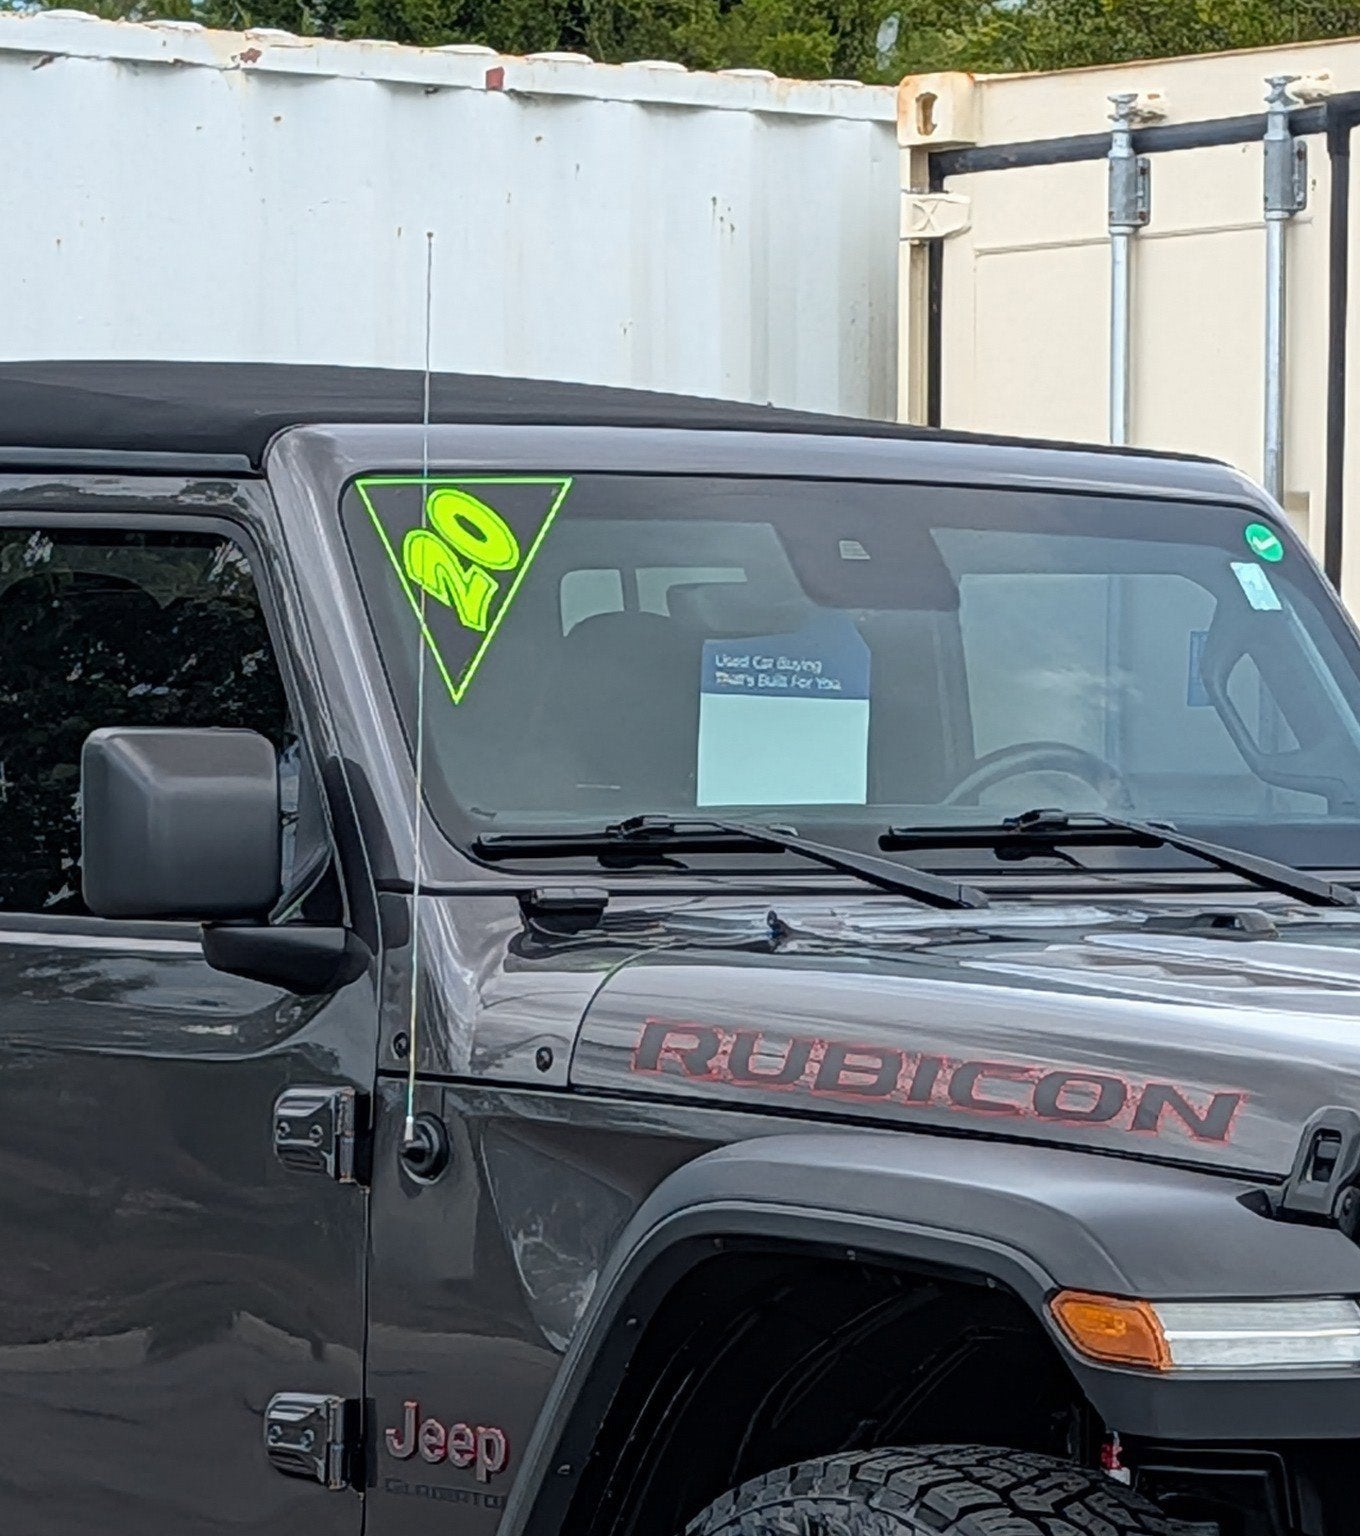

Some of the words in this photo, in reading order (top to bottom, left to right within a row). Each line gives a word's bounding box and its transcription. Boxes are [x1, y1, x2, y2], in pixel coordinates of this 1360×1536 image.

[402, 488, 520, 632] 20
[631, 1016, 1250, 1146] RUBICON
[385, 1400, 509, 1484] Jeep
